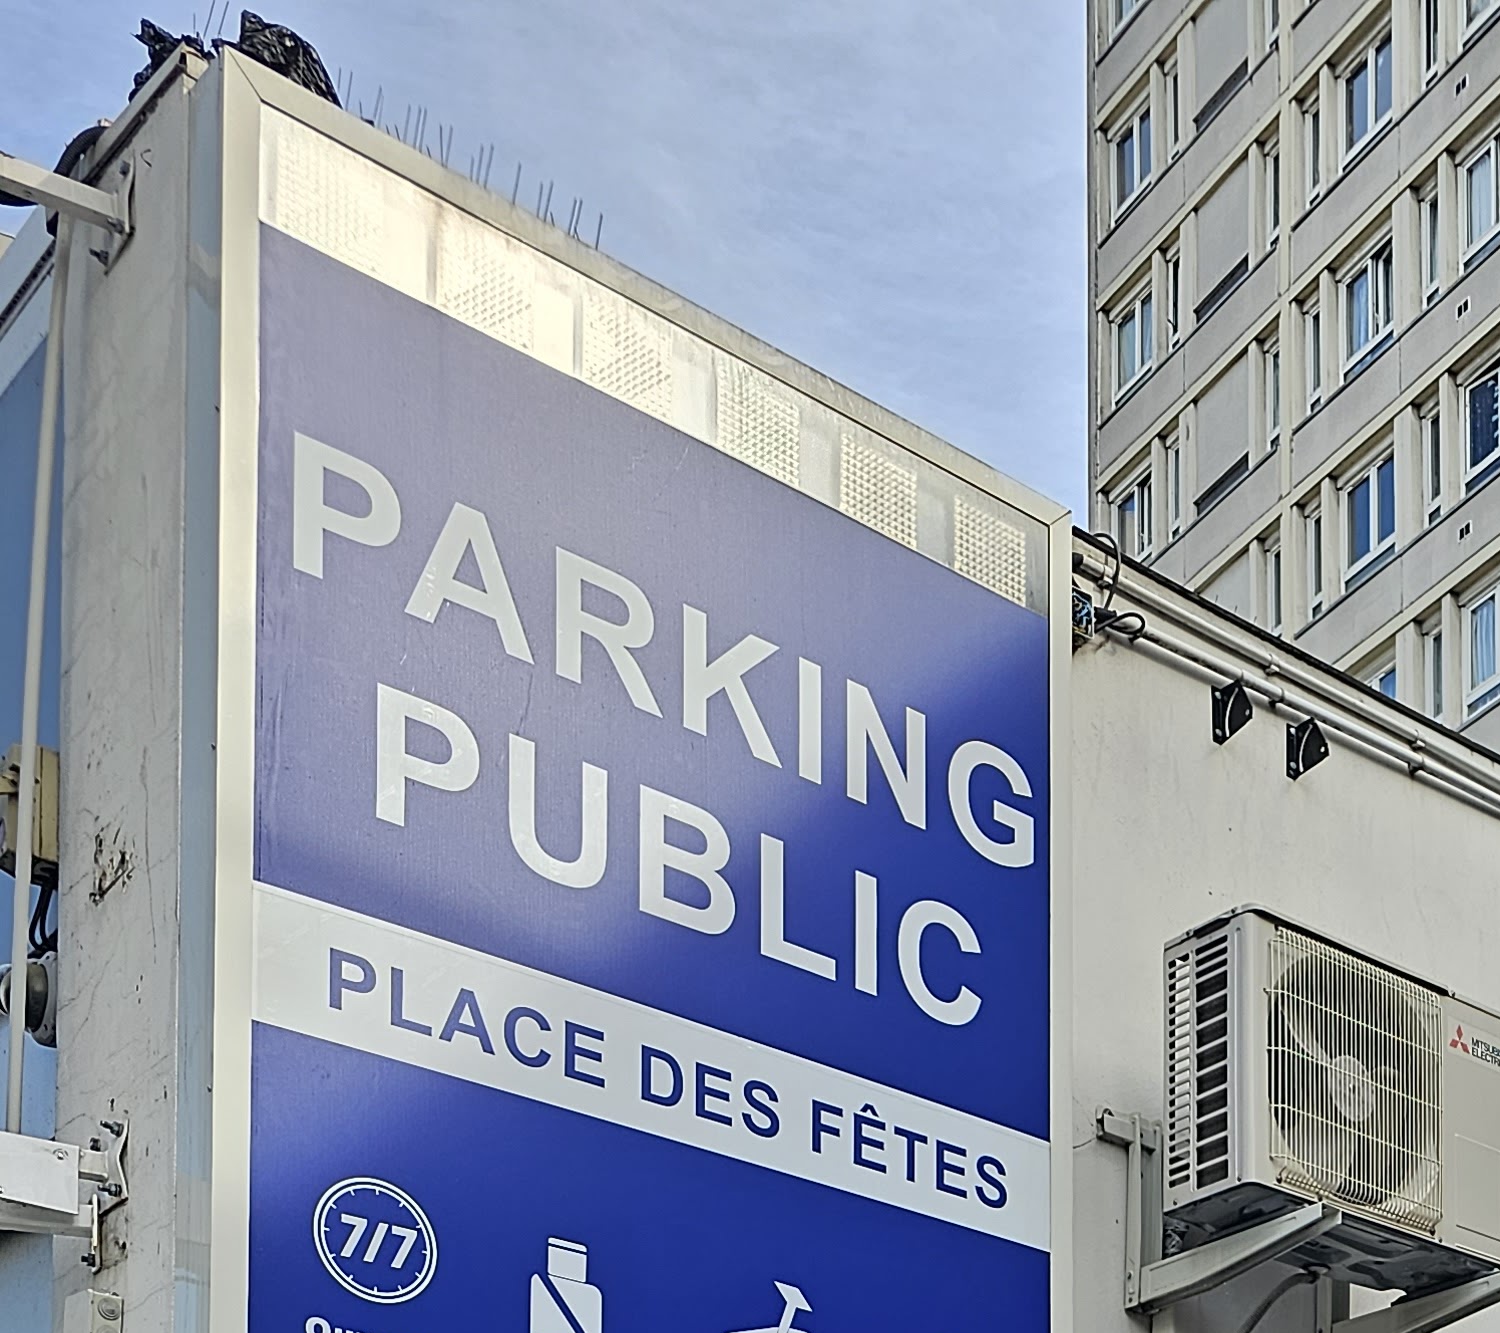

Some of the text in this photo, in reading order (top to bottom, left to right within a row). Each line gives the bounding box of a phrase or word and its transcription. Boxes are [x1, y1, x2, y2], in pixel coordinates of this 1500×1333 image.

[293, 430, 1035, 868] PARKING
[376, 682, 983, 1026] PUBLIC
[329, 948, 1008, 1209] PLACE DES FÊTES
[339, 1212, 419, 1271] 7/7
